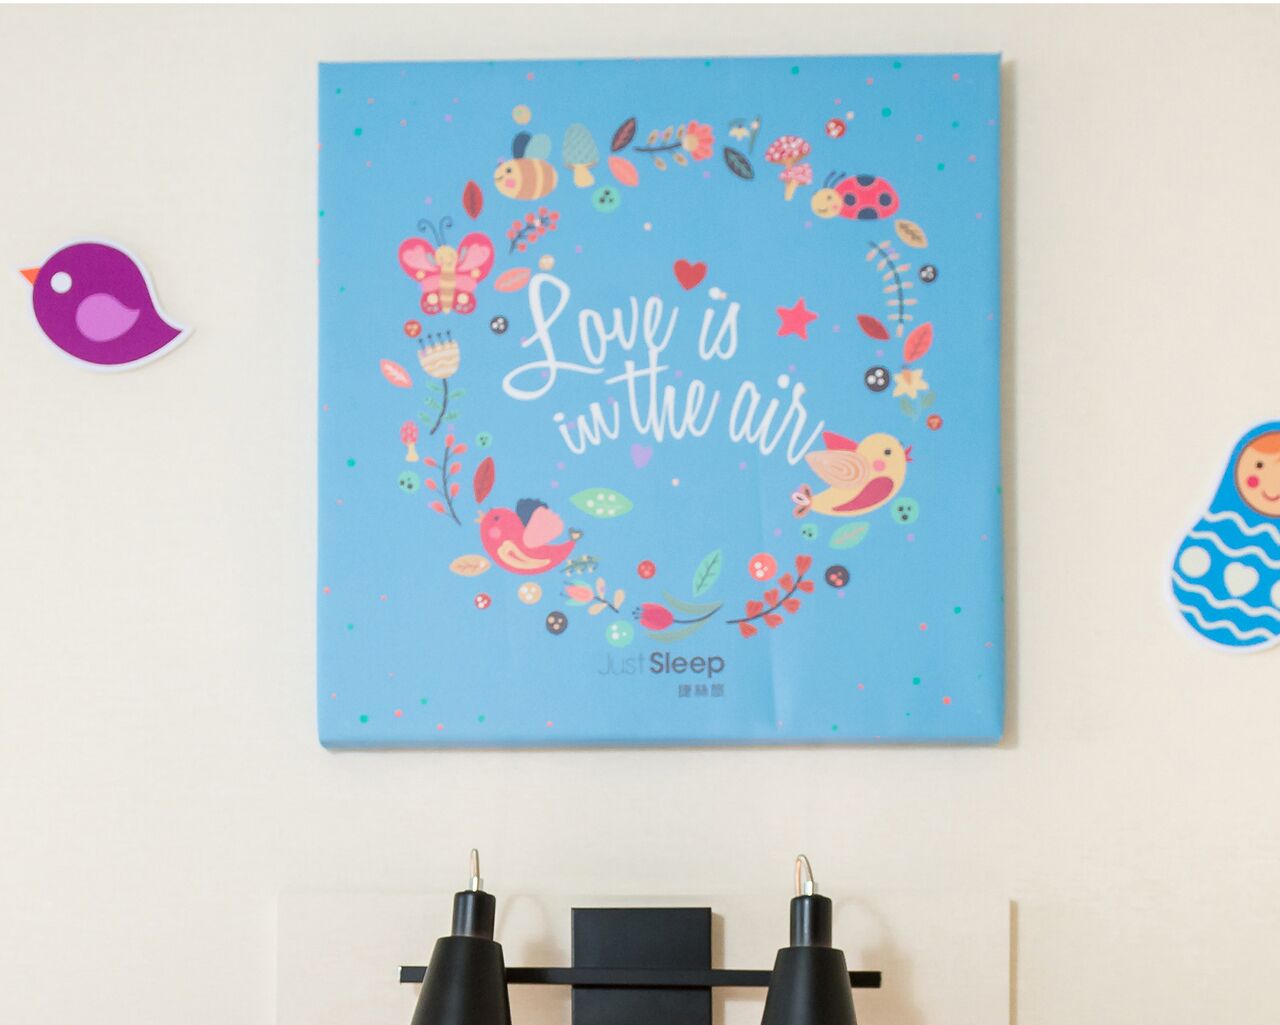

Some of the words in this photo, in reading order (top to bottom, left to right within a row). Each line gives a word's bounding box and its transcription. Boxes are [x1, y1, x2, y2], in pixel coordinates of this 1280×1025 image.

[501, 272, 679, 400] Love
[698, 286, 740, 361] is
[552, 399, 620, 455] in
[604, 348, 721, 443] the
[728, 373, 825, 466] air
[649, 651, 725, 679] Sleep
